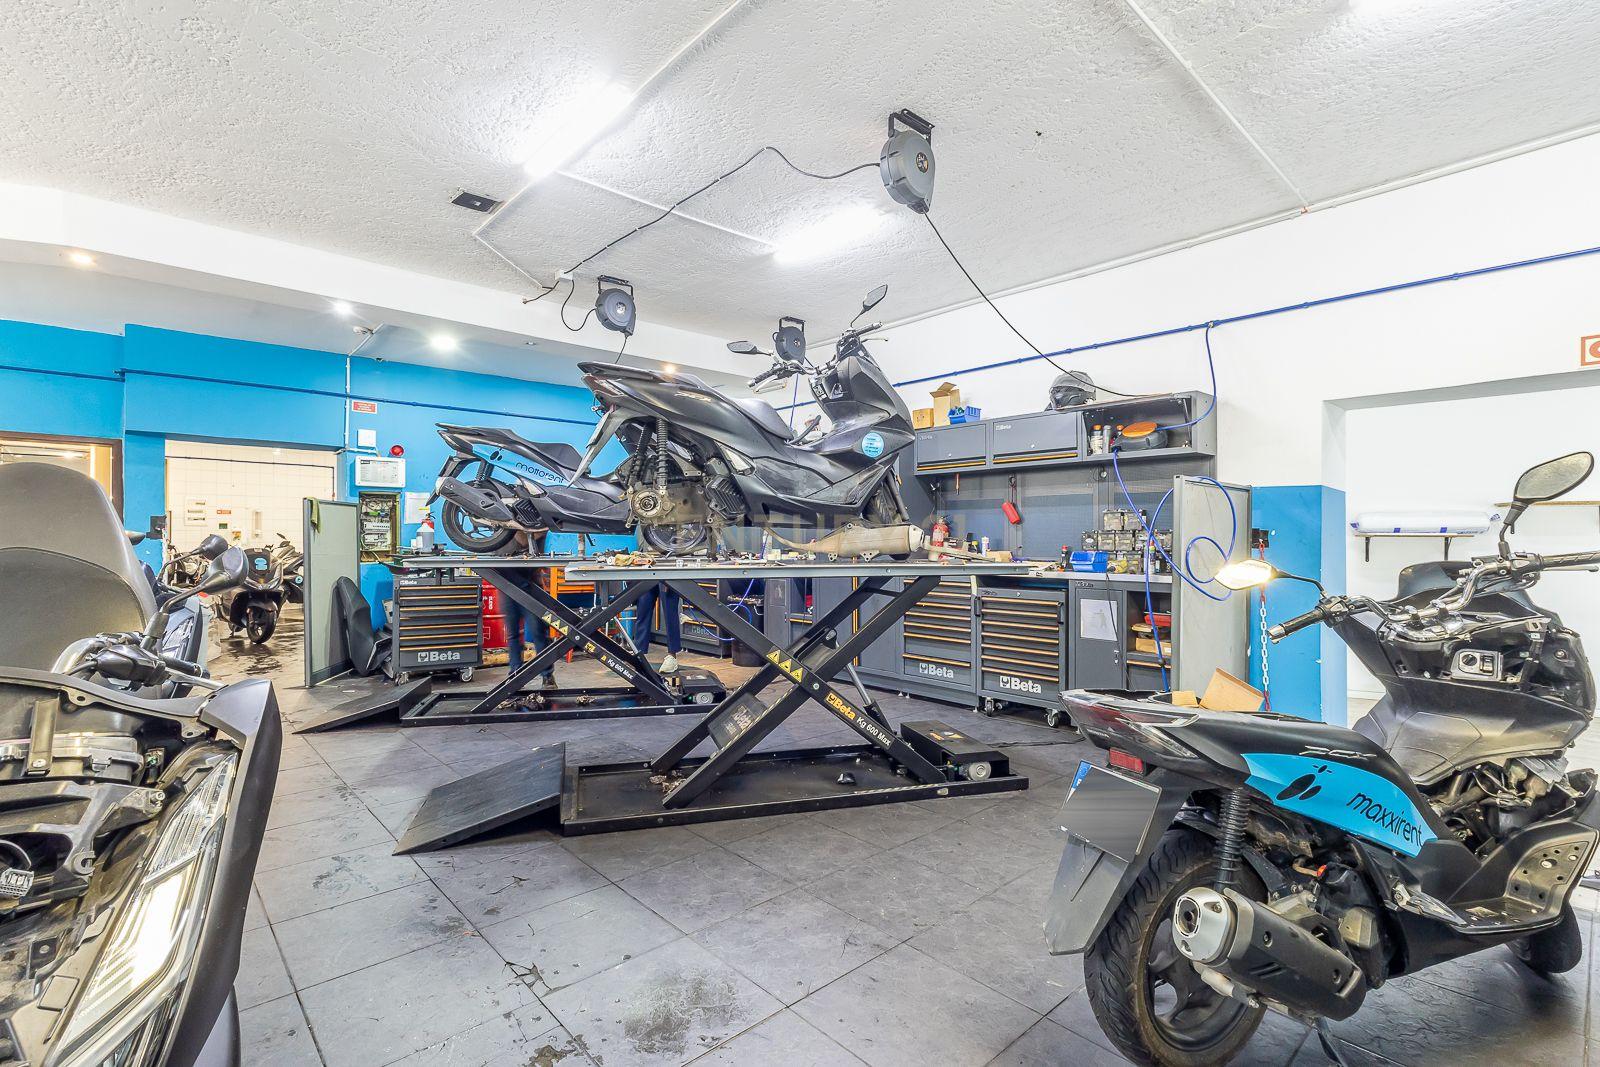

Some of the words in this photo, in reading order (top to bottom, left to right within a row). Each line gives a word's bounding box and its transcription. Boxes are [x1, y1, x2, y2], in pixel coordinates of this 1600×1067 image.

[430, 651, 461, 662] Beta
[928, 663, 954, 679] Beta
[1010, 677, 1042, 694] Beta
[833, 697, 856, 720] Beta
[856, 716, 867, 729] Kg
[866, 724, 879, 736] 600
[877, 732, 891, 746] Max
[1346, 792, 1424, 847] maxxirent
